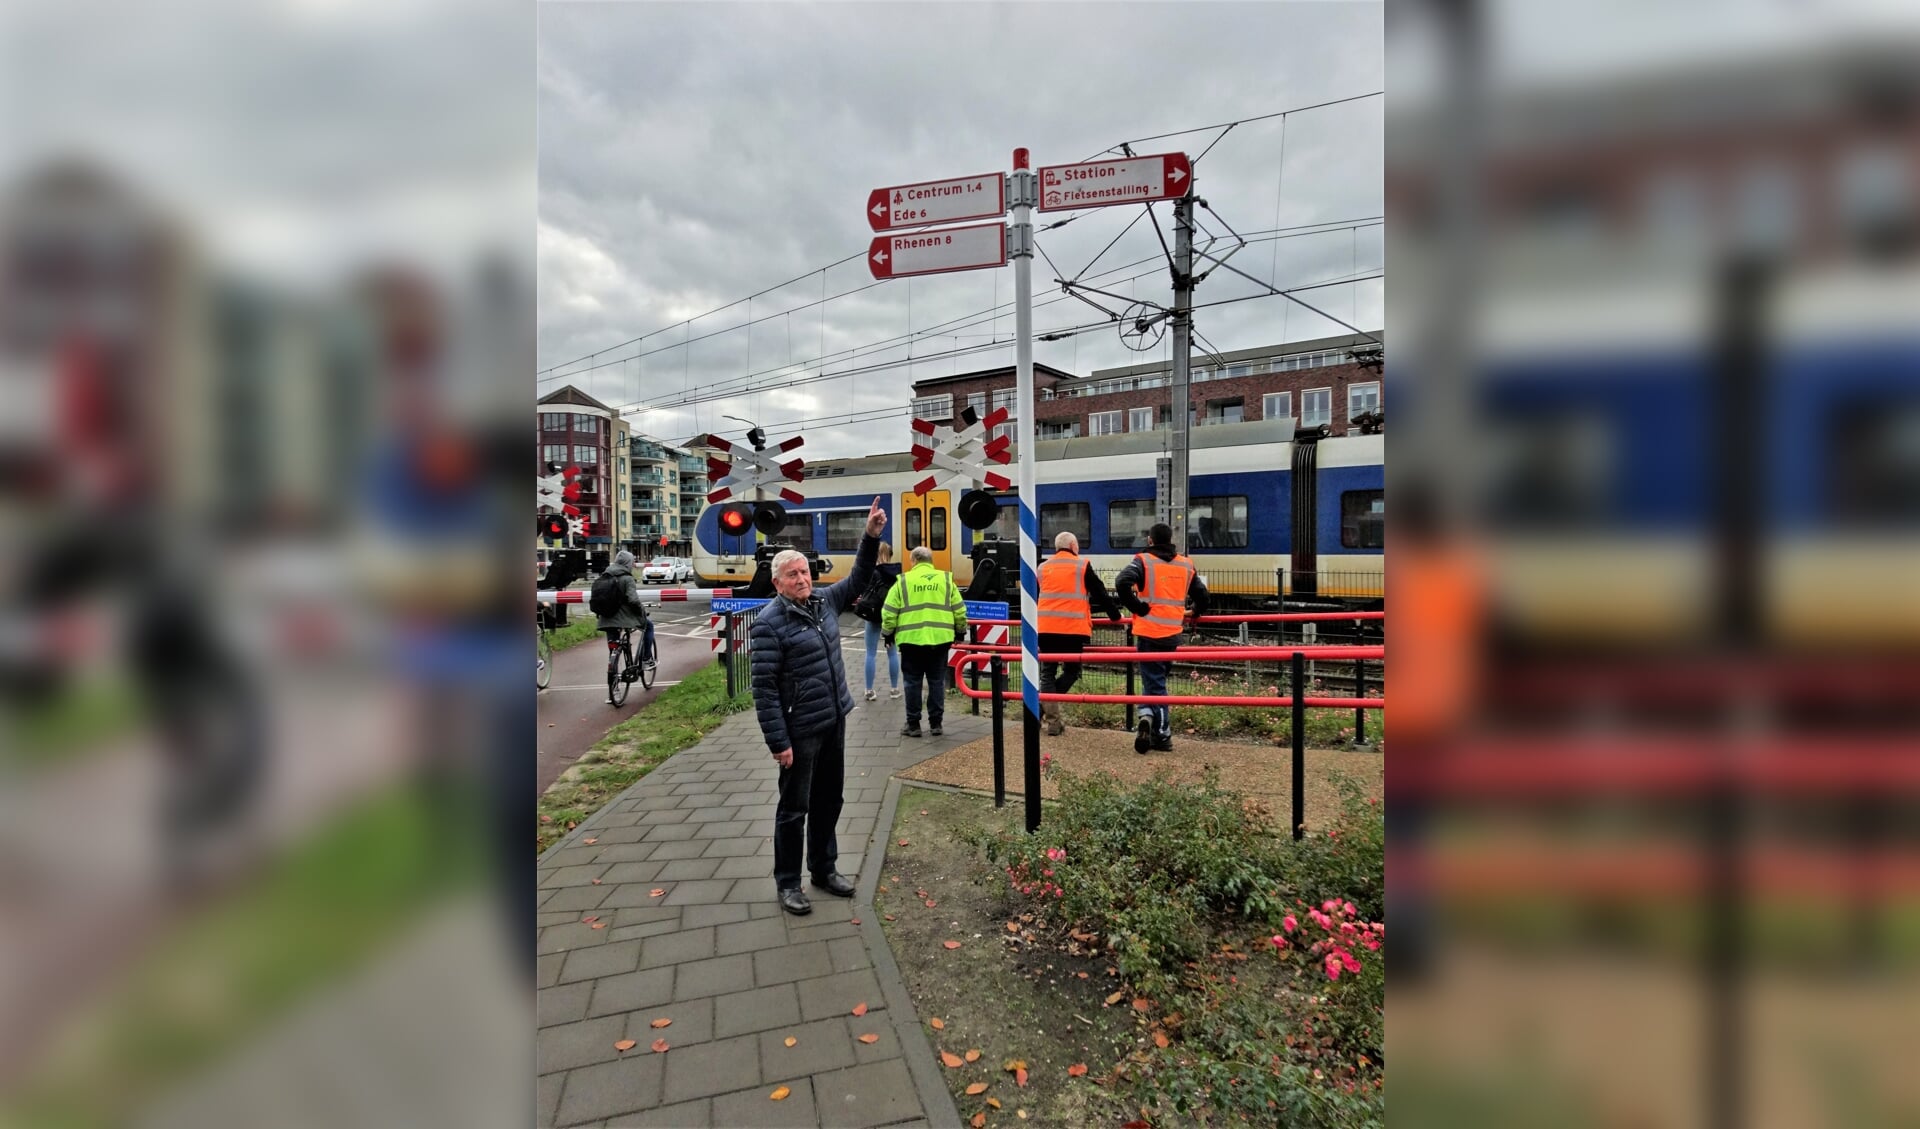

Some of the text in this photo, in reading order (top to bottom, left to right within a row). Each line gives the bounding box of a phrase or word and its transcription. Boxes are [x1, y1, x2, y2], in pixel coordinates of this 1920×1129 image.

[1064, 166, 1115, 181] Station
[908, 182, 982, 200] Centrum 1.4
[1063, 184, 1149, 201] Fietsenstalling
[894, 209, 927, 221] Ede 6
[894, 235, 952, 250] Rhenen 8
[816, 512, 822, 526] 1
[913, 583, 939, 593] Inrail
[712, 601, 743, 610] WACHT
